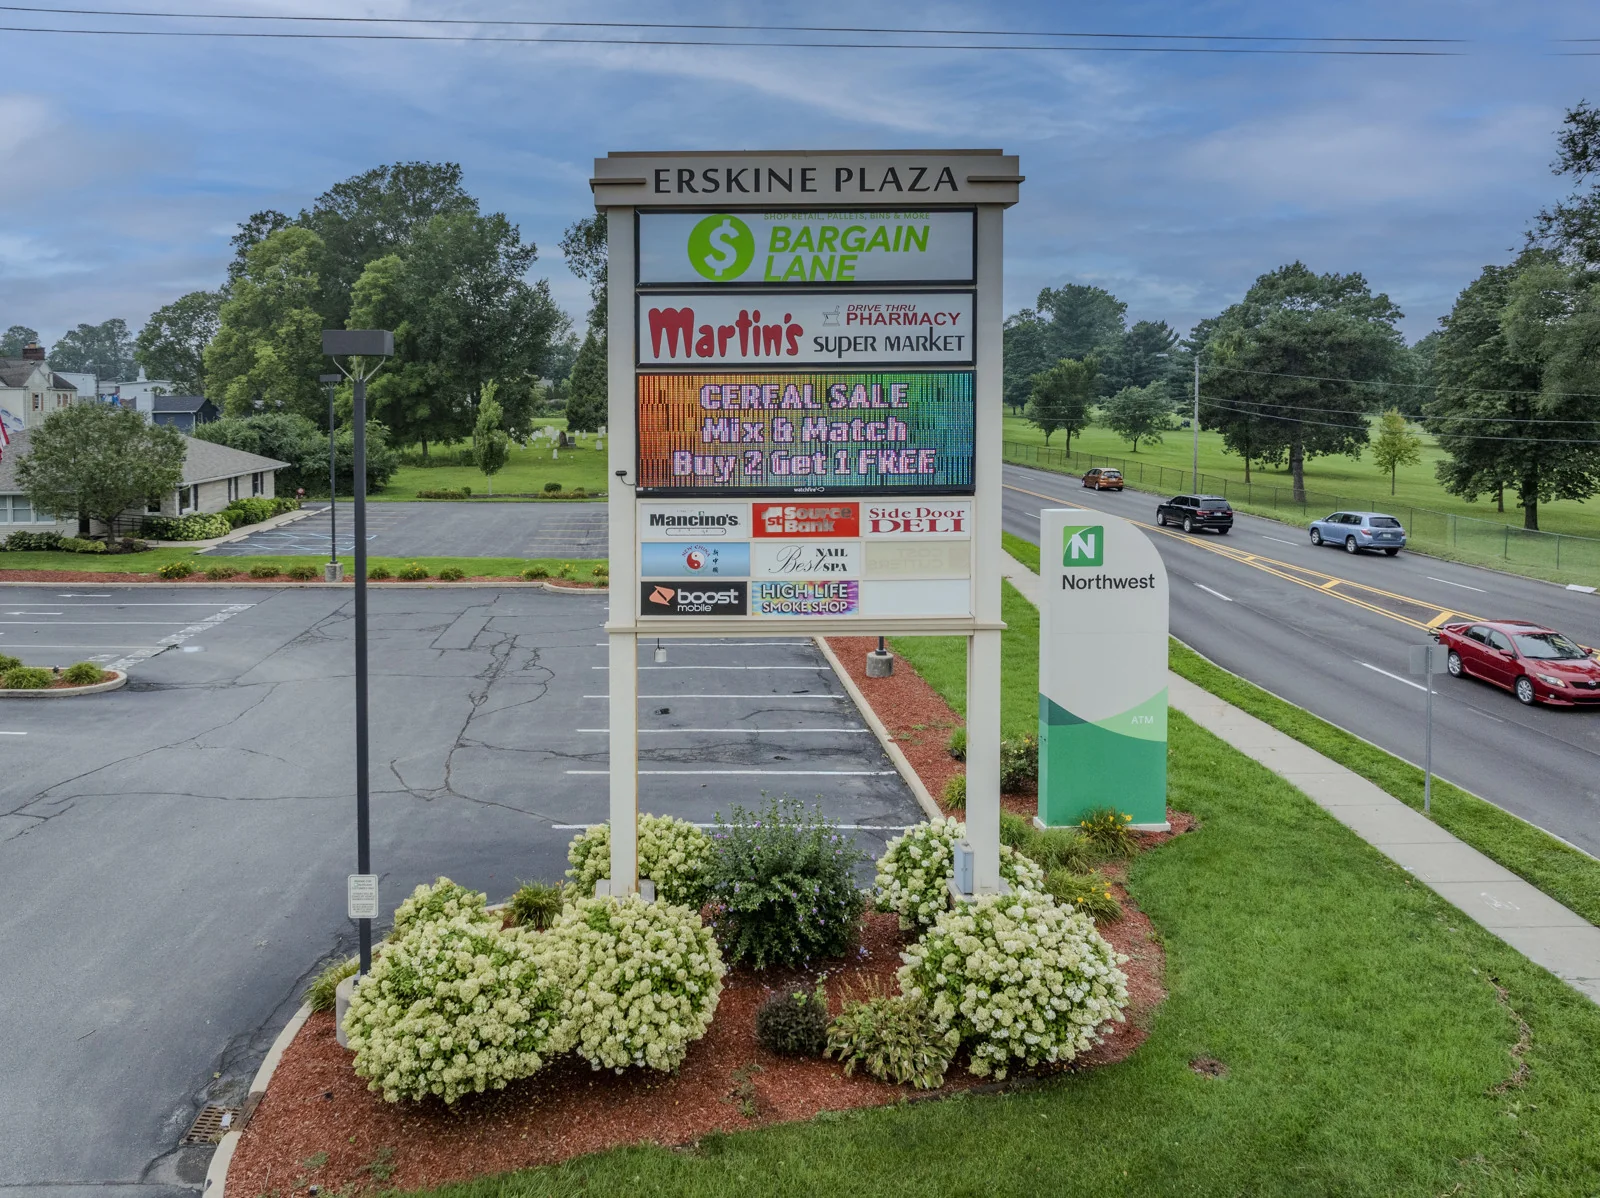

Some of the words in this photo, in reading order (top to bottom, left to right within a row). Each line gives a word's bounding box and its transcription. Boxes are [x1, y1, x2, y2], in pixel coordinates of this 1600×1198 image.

[654, 167, 818, 194] ERSKINE
[835, 166, 960, 193] PLAZA
[763, 212, 789, 221] SHOP
[791, 212, 825, 221] RETAIL,
[827, 212, 868, 221] PALLETS,
[869, 212, 891, 220] BINS
[893, 212, 901, 220] &
[903, 212, 931, 220] MORE
[768, 225, 931, 253] BARGAIN
[763, 254, 859, 282] LANE
[846, 304, 883, 312] DRIVE
[884, 304, 916, 312] THRU
[846, 312, 962, 326] PHARMACY
[648, 307, 804, 359] Martin's
[813, 335, 877, 359] SUPER
[701, 383, 822, 410] CEREAL
[829, 383, 910, 410] SALE
[702, 417, 765, 443] Mix
[801, 416, 907, 443] Match
[674, 450, 736, 483] Buy
[744, 450, 763, 475] 2
[770, 450, 826, 475] Get
[833, 450, 850, 475] 1
[858, 449, 936, 475] FREE
[649, 511, 739, 527] Mancino's
[784, 506, 852, 520] Source
[869, 507, 911, 519] Side
[915, 507, 965, 518] Door
[784, 519, 835, 533] Bank
[868, 519, 965, 533] DELI
[816, 548, 848, 557] NAIL
[1071, 533, 1096, 559] N
[768, 545, 827, 574] Best
[822, 563, 848, 572] SPA
[1062, 573, 1155, 590] Northwest
[677, 588, 739, 604] boost
[761, 583, 808, 599] HIGH
[814, 583, 848, 599] LIFE
[677, 604, 712, 612] mobile
[762, 601, 808, 613] SMOKE
[811, 601, 848, 613] SHOP
[1131, 715, 1154, 724] ATM
